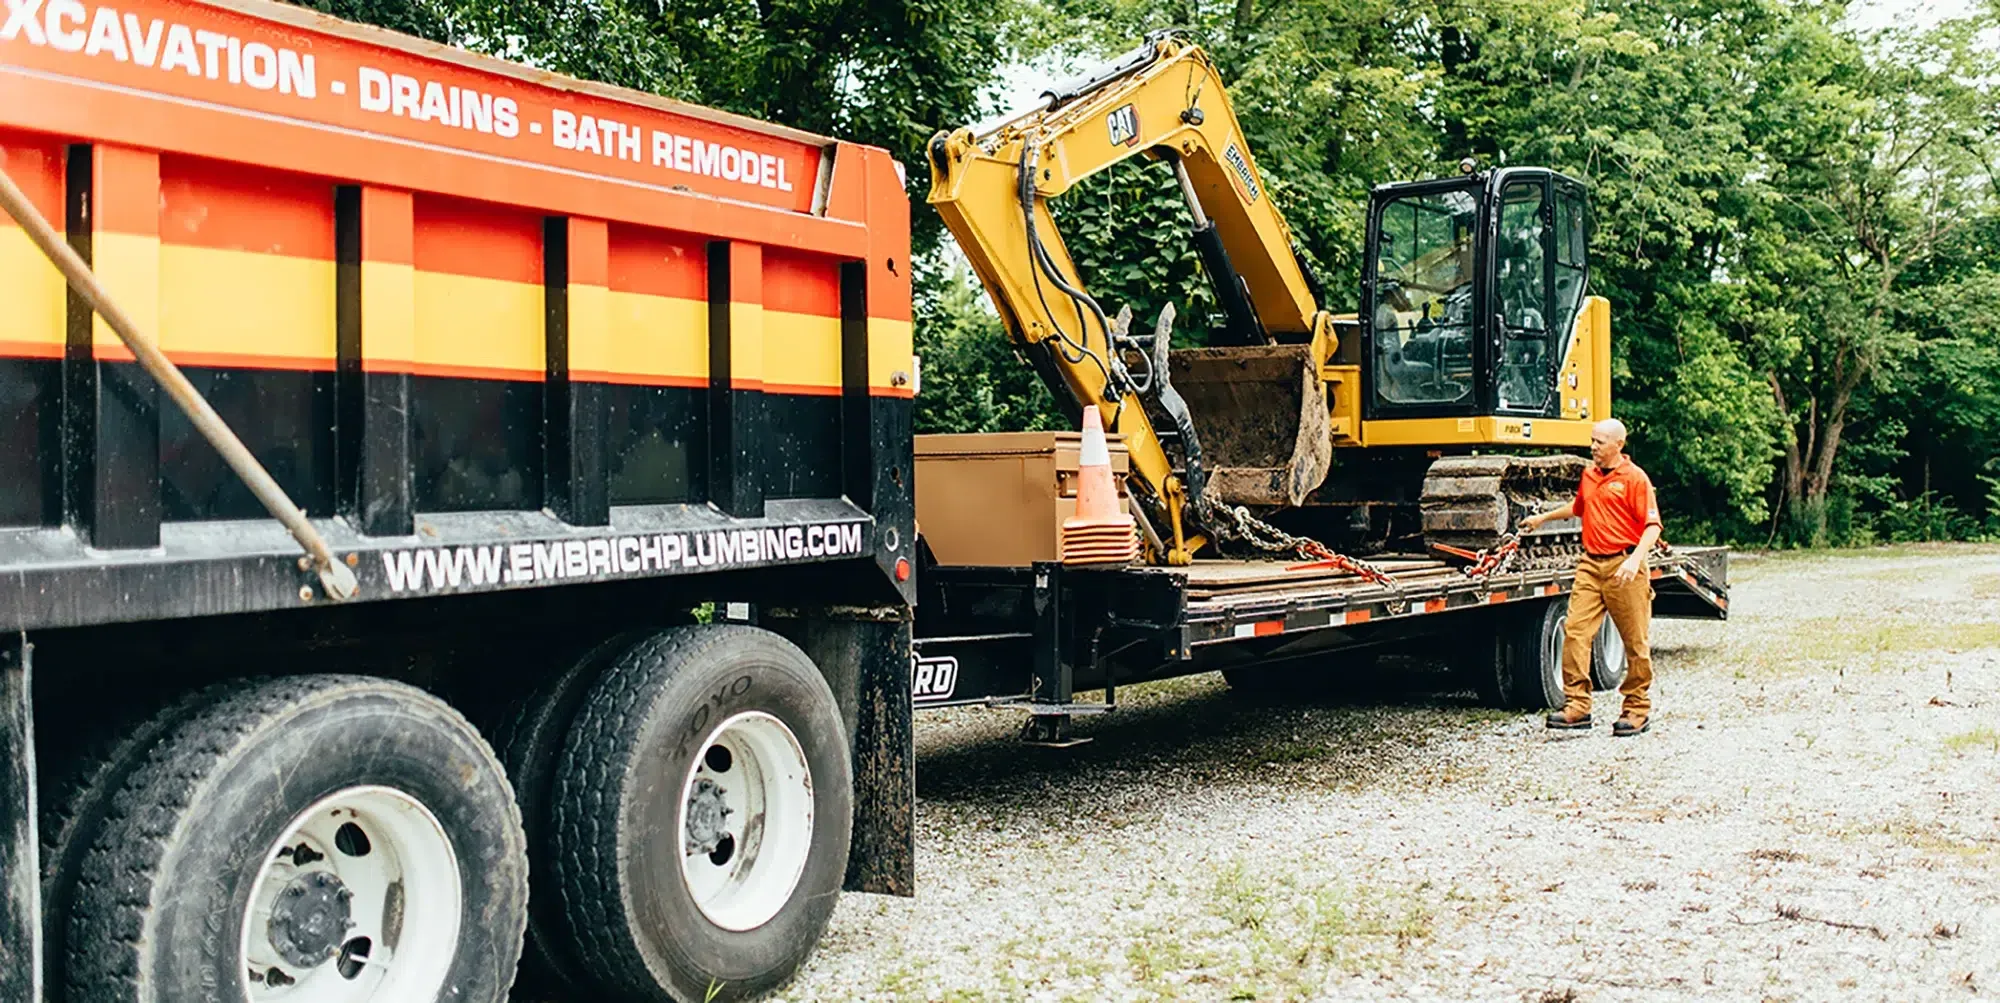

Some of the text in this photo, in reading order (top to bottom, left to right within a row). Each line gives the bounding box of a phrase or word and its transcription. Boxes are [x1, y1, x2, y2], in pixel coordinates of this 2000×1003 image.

[358, 65, 520, 138] DRAINS
[552, 108, 641, 162] BATH
[652, 130, 792, 192] REMODEL
[1107, 104, 1136, 145] CAT
[1226, 144, 1258, 197] EMBRICH
[383, 523, 862, 592] WWW.EMBRICHPLUMBING.COM
[671, 675, 752, 761] TOYO
